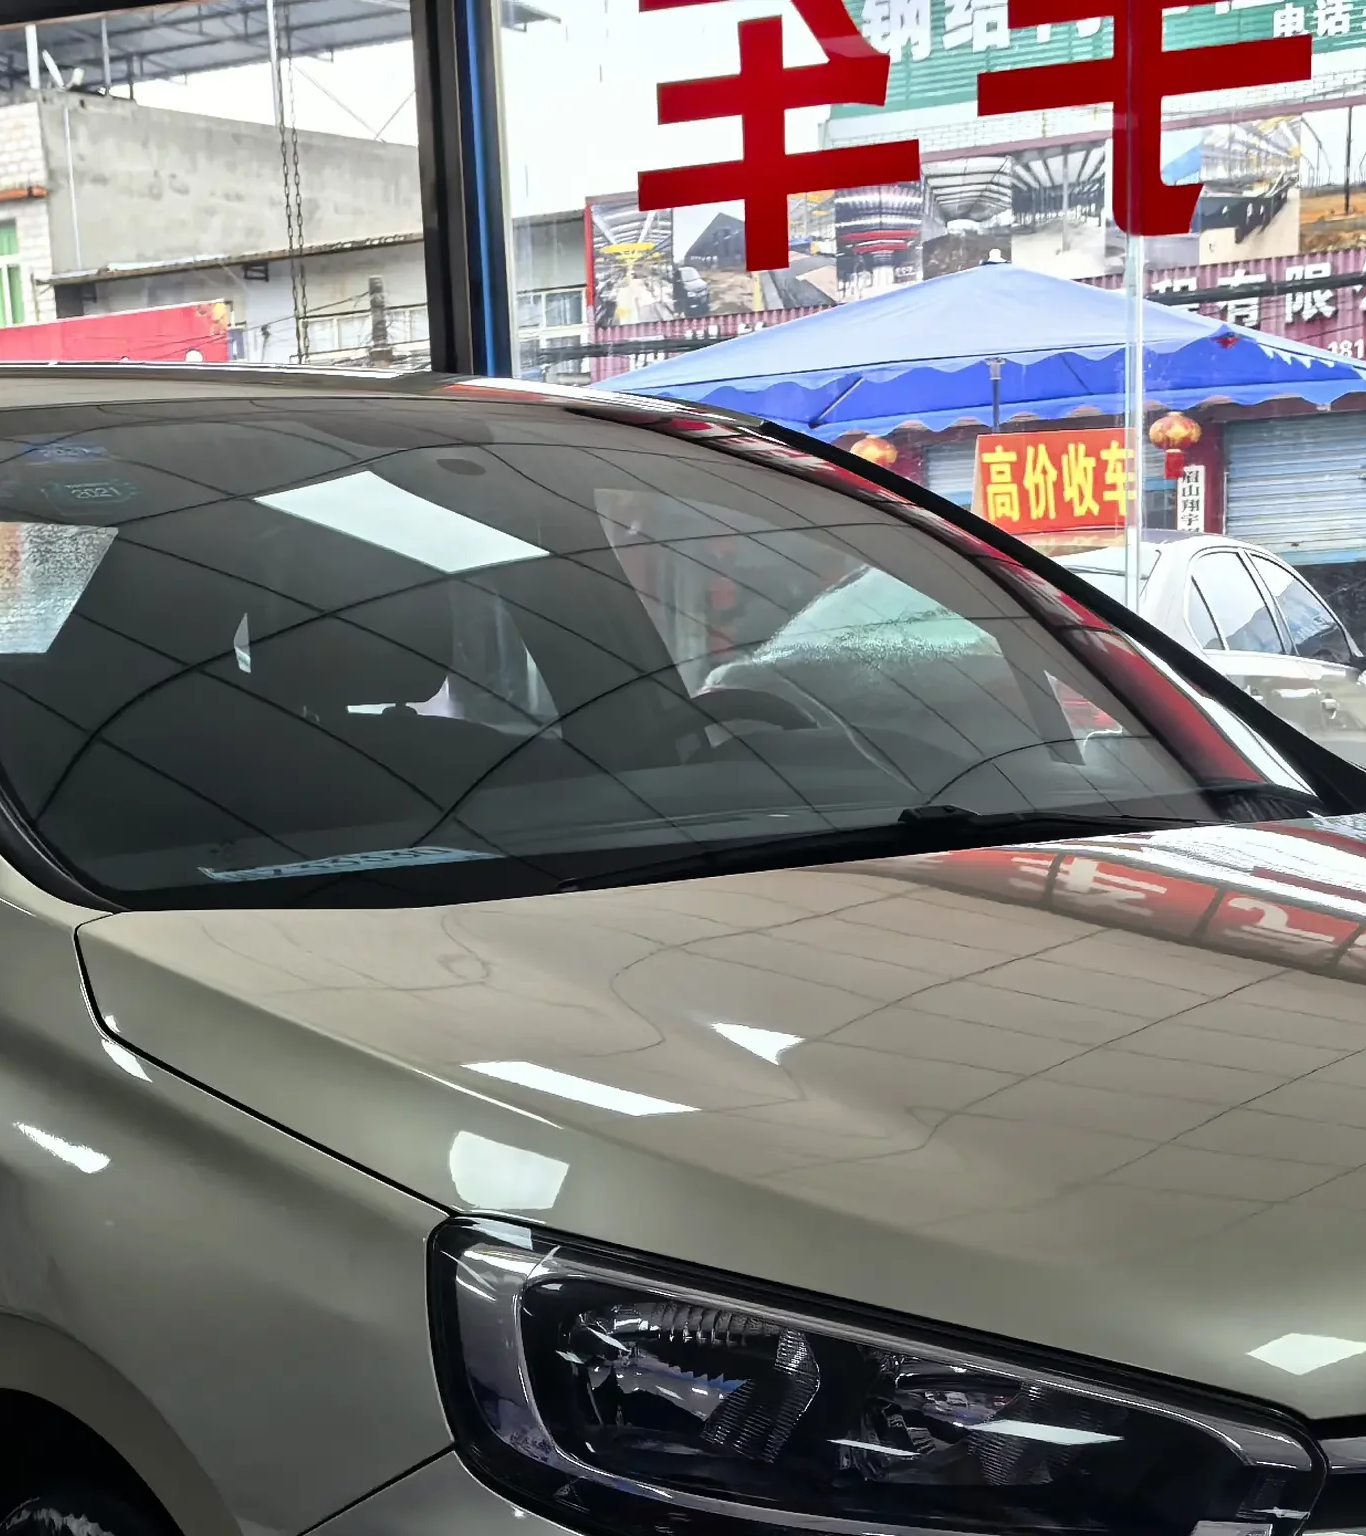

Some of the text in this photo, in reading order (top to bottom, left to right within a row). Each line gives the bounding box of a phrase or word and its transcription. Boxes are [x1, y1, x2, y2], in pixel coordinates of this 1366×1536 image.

[861, 0, 1104, 63] 钢结
[981, 440, 1138, 522] 高价收车
[1181, 470, 1200, 533] 眉山翔宇
